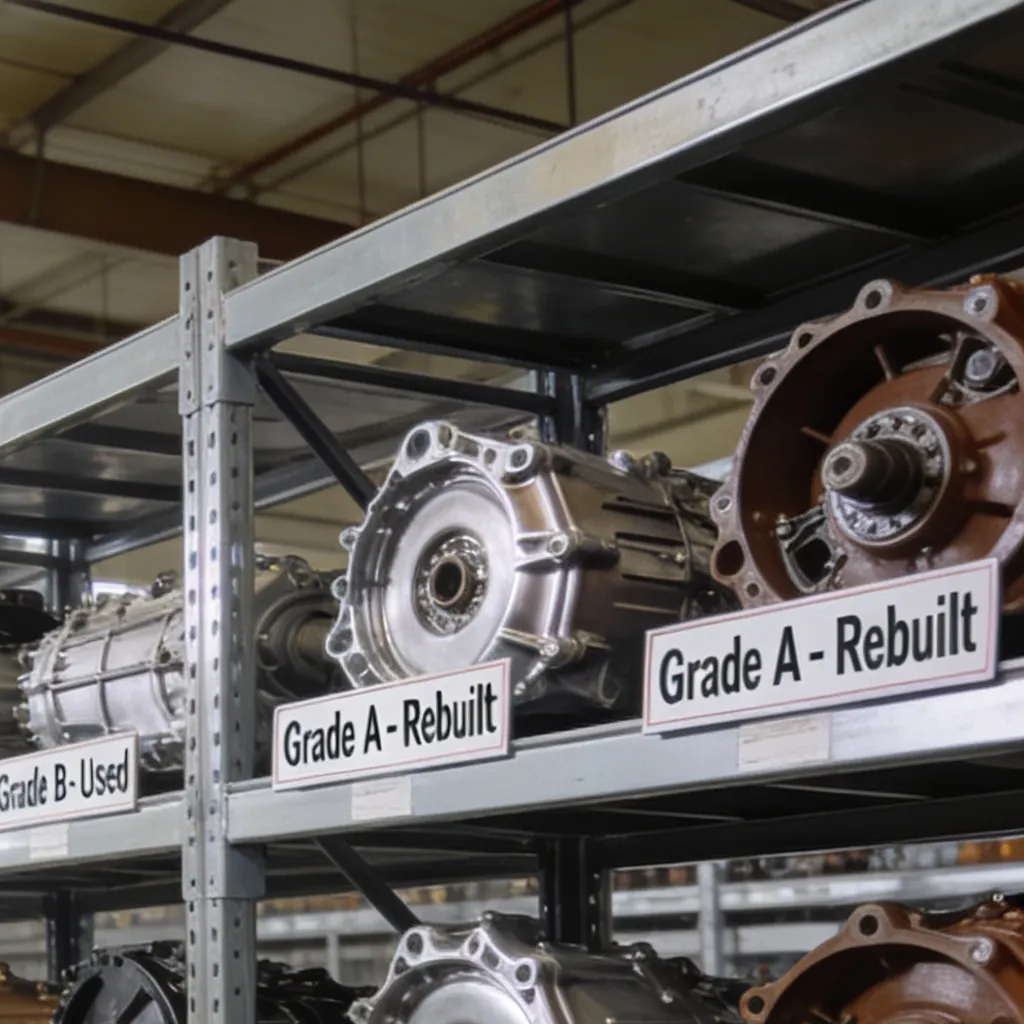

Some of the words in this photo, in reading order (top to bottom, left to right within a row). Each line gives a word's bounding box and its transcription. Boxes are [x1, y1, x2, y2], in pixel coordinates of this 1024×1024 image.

[659, 634, 762, 705] Grade
[773, 625, 801, 686] A
[836, 591, 979, 675] Rebuilt
[284, 710, 355, 767] Grade
[363, 704, 382, 754] A
[403, 682, 498, 747] Rebuilt
[80, 747, 129, 799] Used
